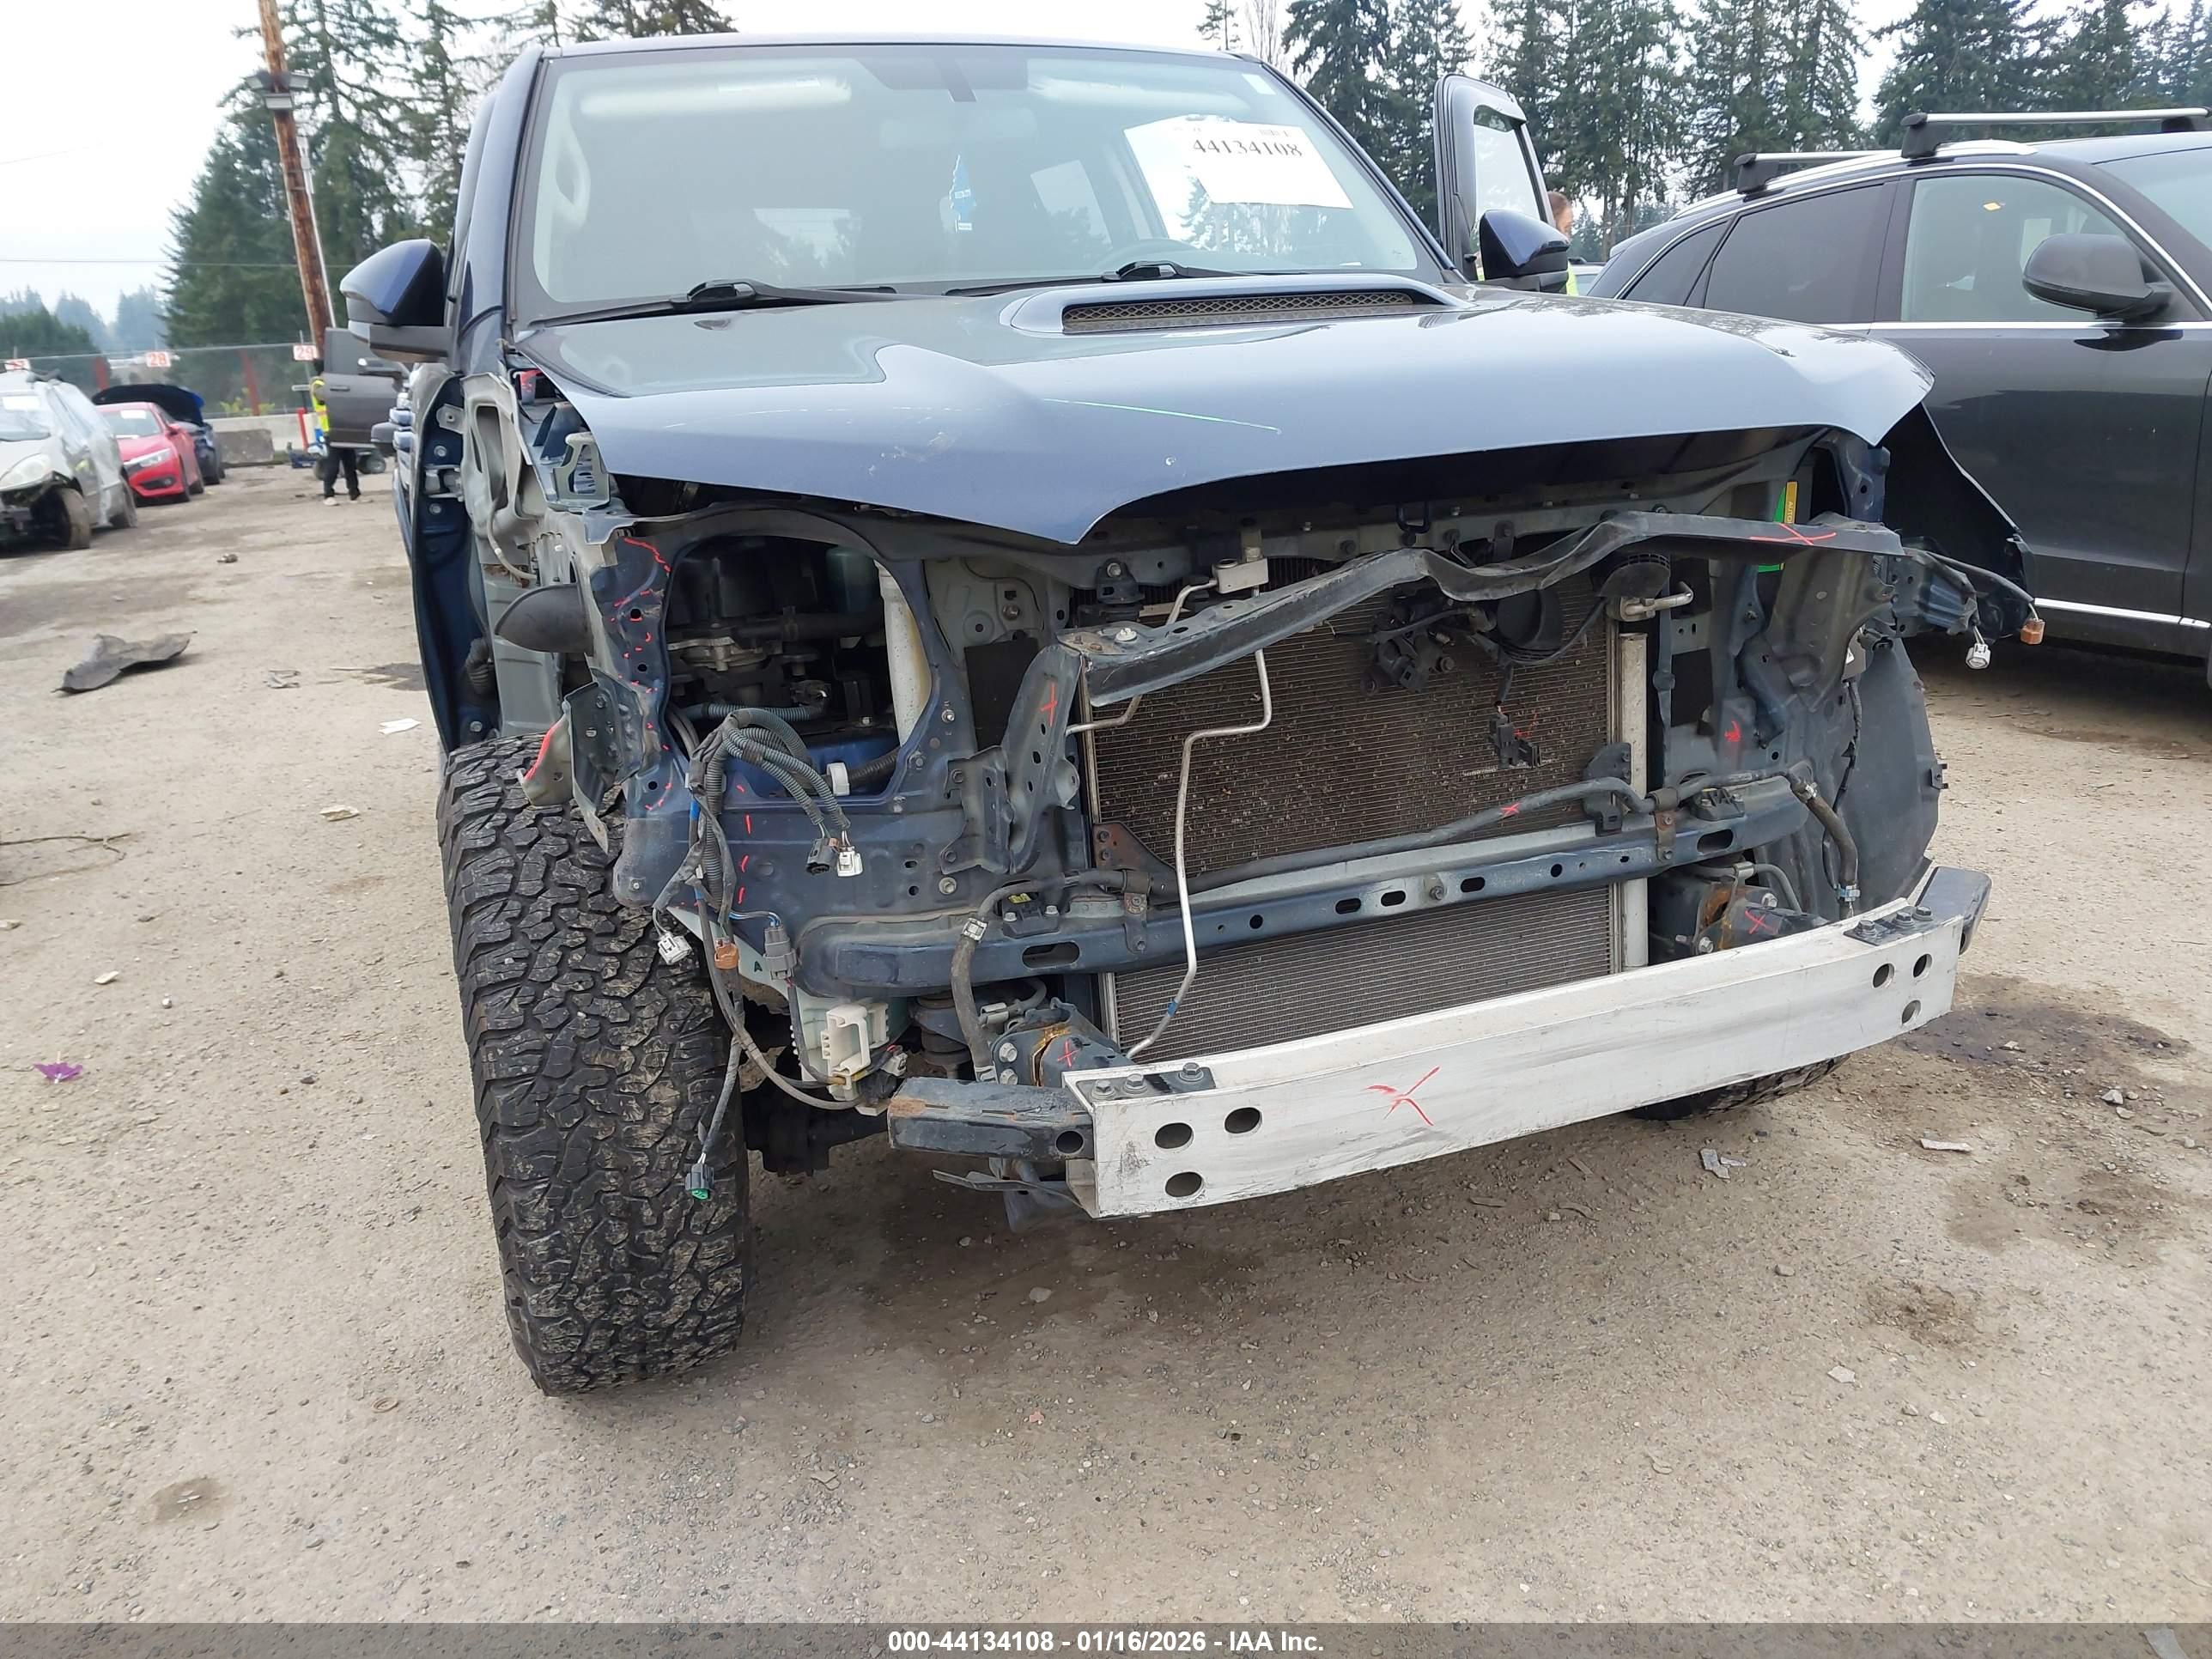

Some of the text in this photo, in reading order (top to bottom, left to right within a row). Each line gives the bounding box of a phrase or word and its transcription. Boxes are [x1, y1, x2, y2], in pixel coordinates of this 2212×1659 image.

[1193, 138, 1303, 157] 44134108
[149, 352, 167, 367] 28
[296, 345, 314, 360] 29
